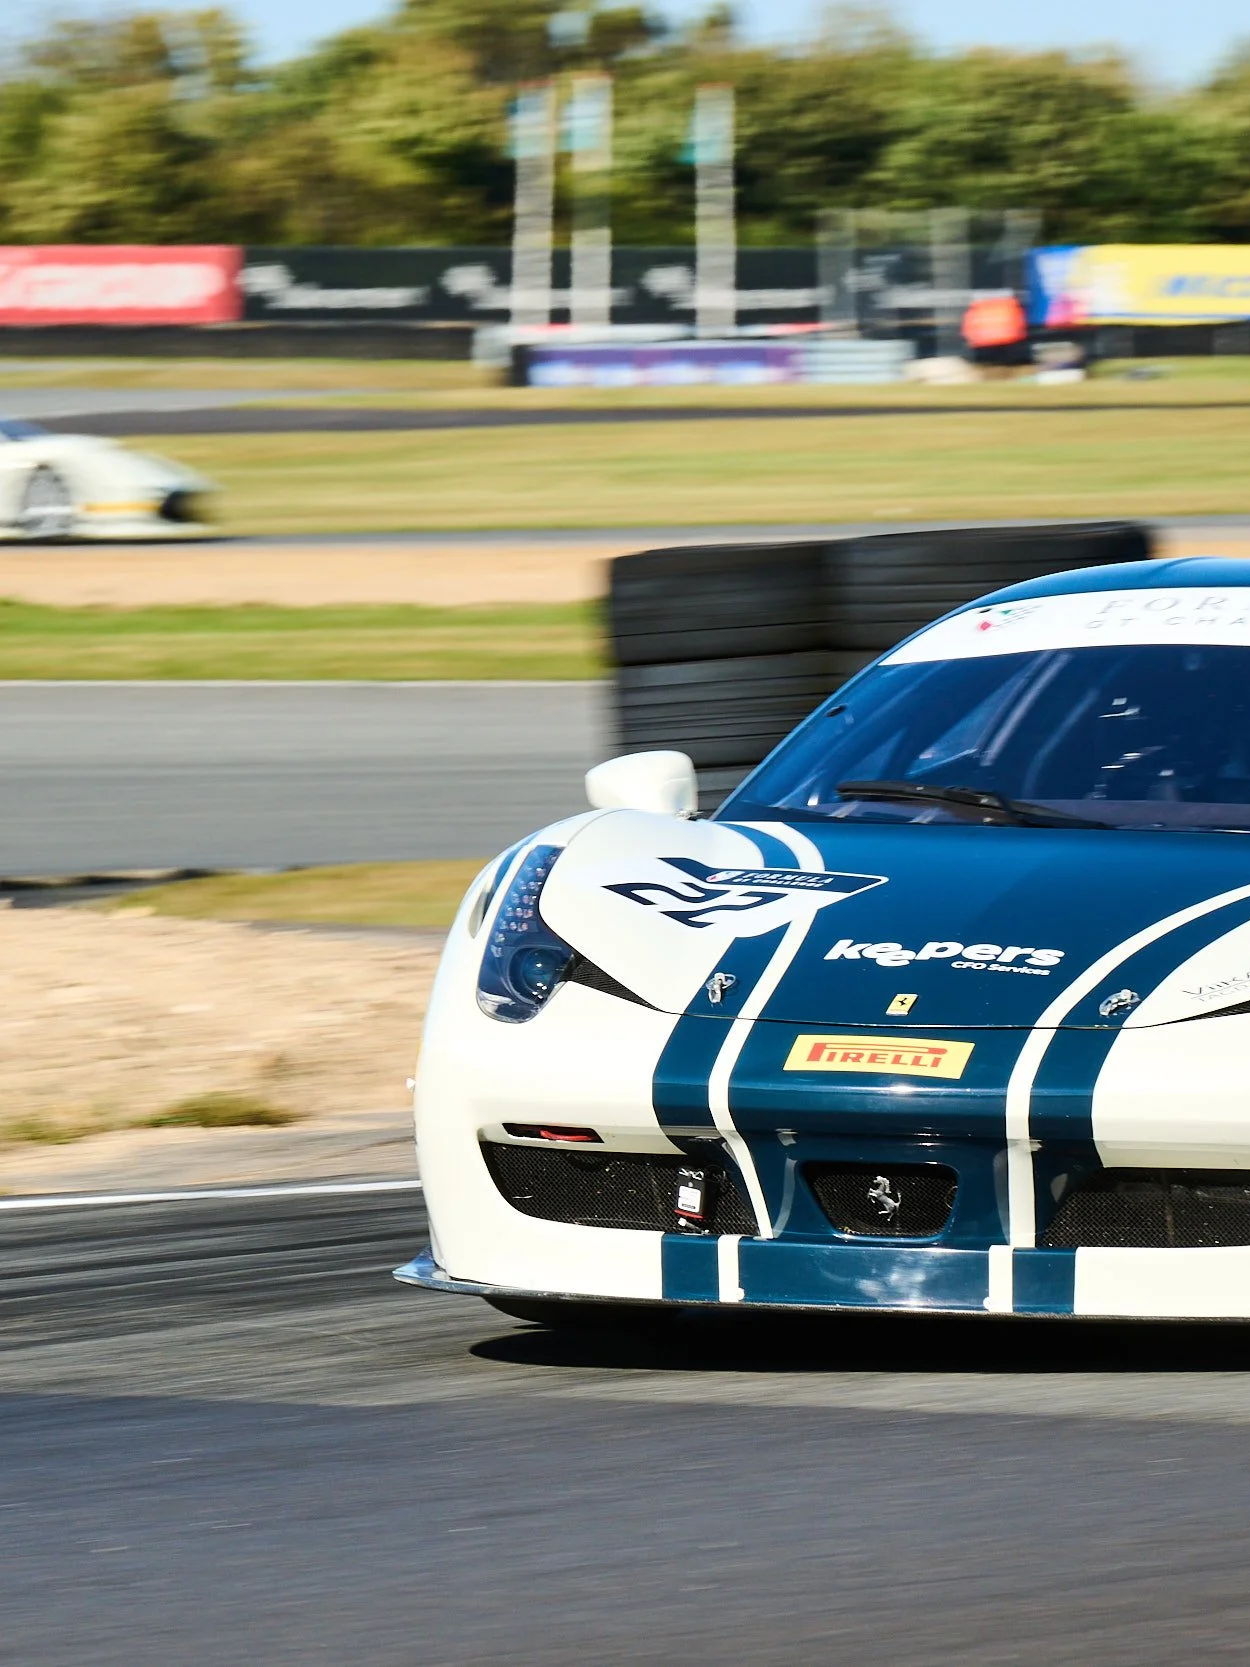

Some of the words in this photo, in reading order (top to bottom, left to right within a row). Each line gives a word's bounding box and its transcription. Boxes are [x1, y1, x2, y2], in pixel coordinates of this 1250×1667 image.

[742, 872, 834, 884] FORMULA
[824, 938, 1065, 967] keepers
[951, 961, 987, 971] CFO
[988, 963, 1050, 976] Services
[806, 1042, 949, 1068] PIRELLI
